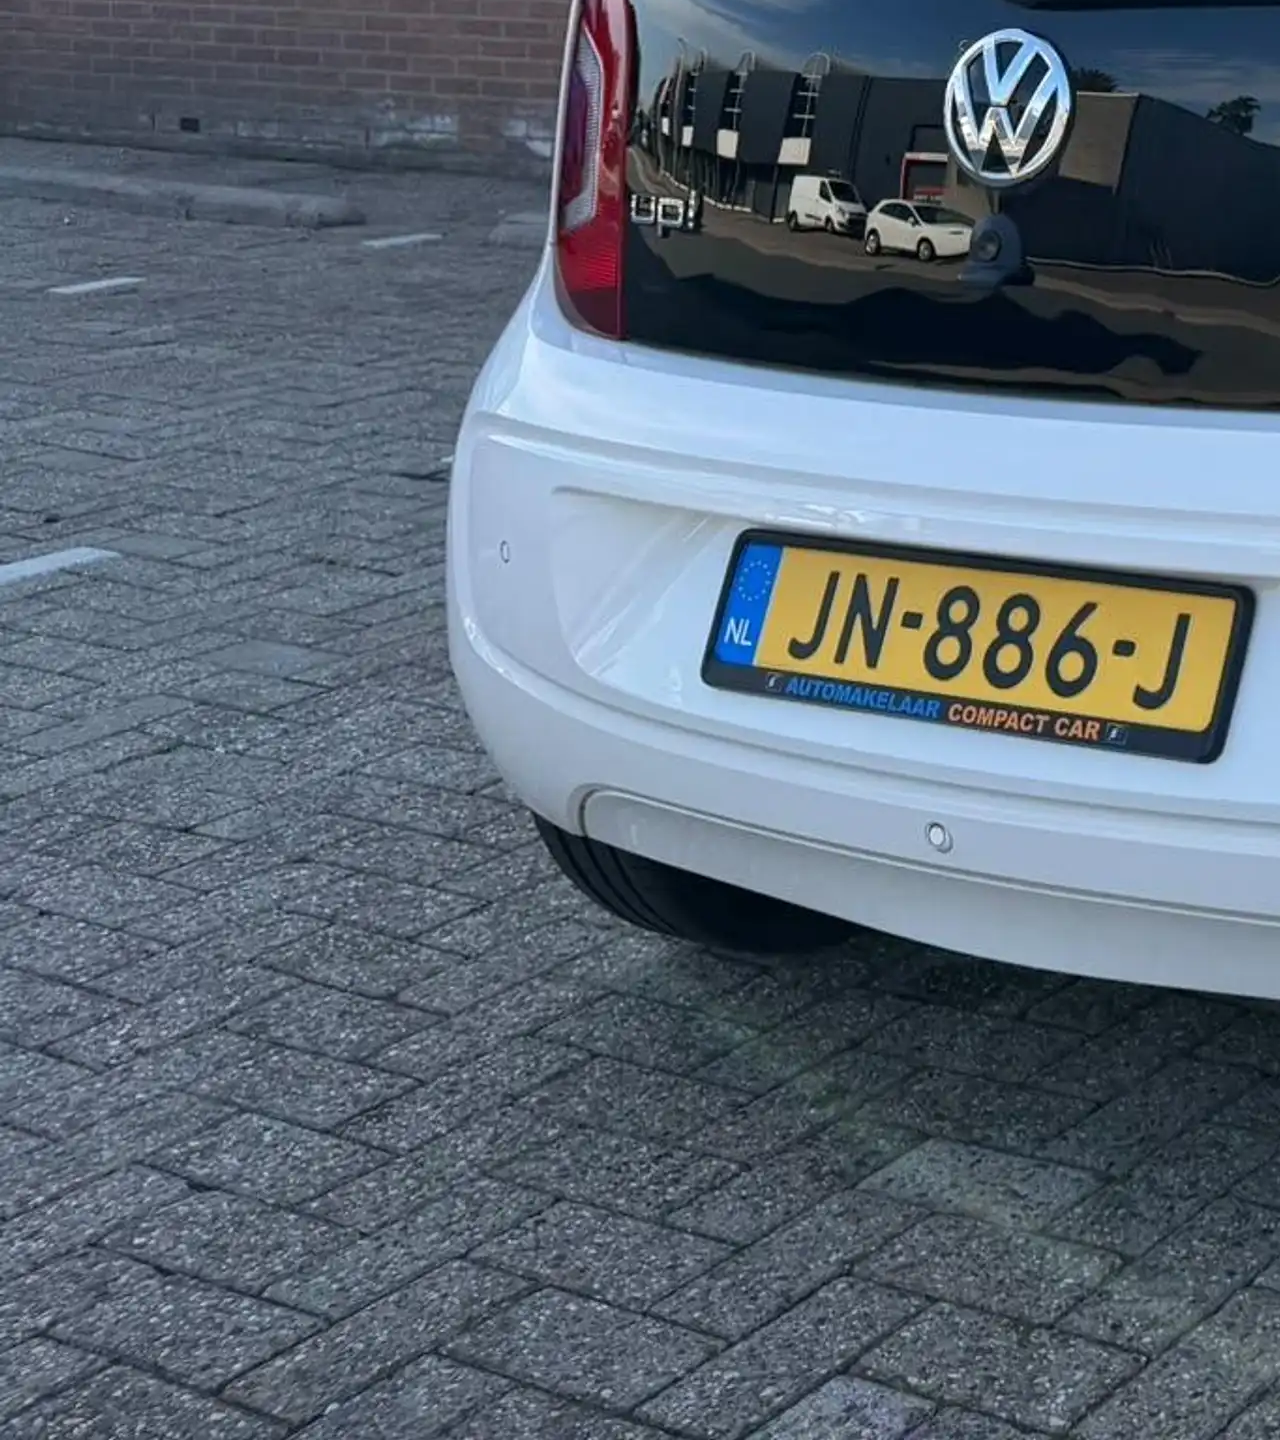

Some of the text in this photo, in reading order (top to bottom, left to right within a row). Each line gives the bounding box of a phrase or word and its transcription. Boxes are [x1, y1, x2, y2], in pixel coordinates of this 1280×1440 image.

[724, 618, 752, 647] NL
[787, 570, 1191, 710] JN-886-J
[785, 676, 1101, 741] AUTOMAKELAAR COMPACT CAR
